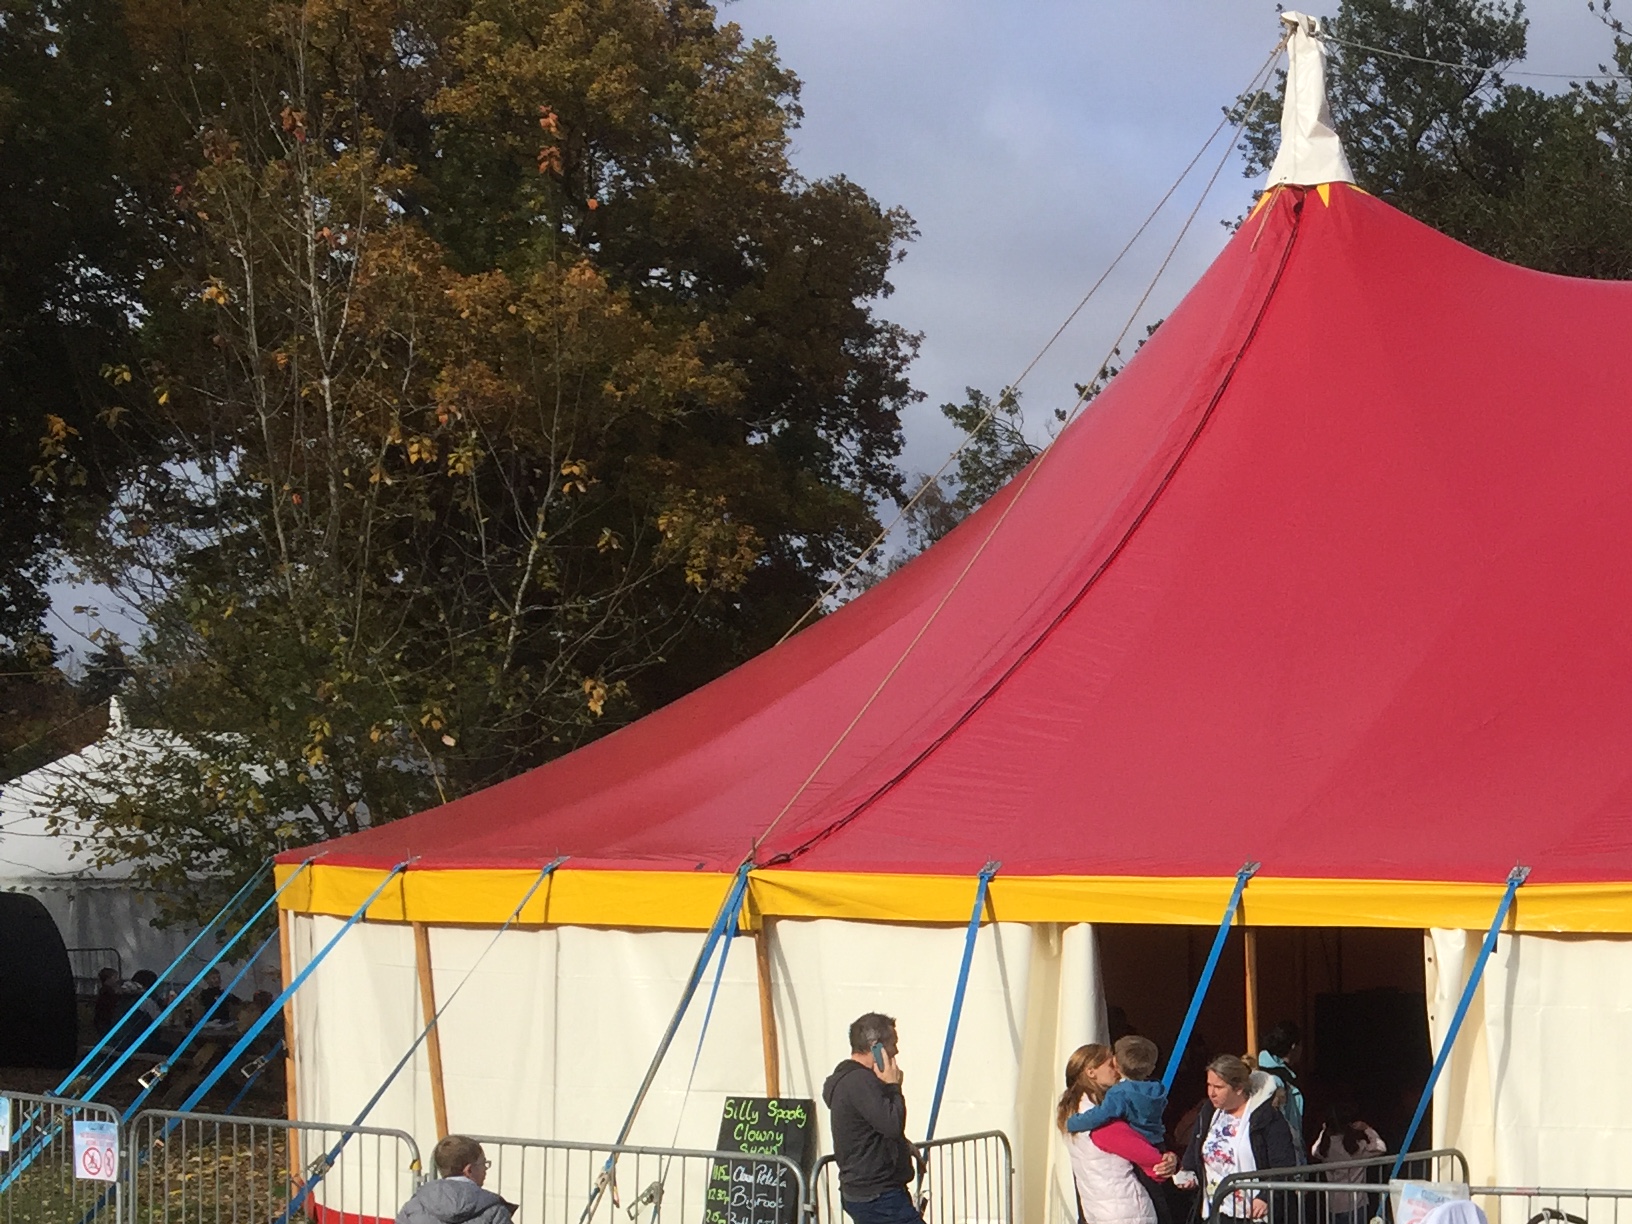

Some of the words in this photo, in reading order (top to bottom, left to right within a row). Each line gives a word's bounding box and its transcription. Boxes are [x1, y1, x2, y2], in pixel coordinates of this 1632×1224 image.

[724, 1099, 759, 1125] Silly
[767, 1100, 807, 1129] Spooky
[733, 1123, 784, 1147] Clowny
